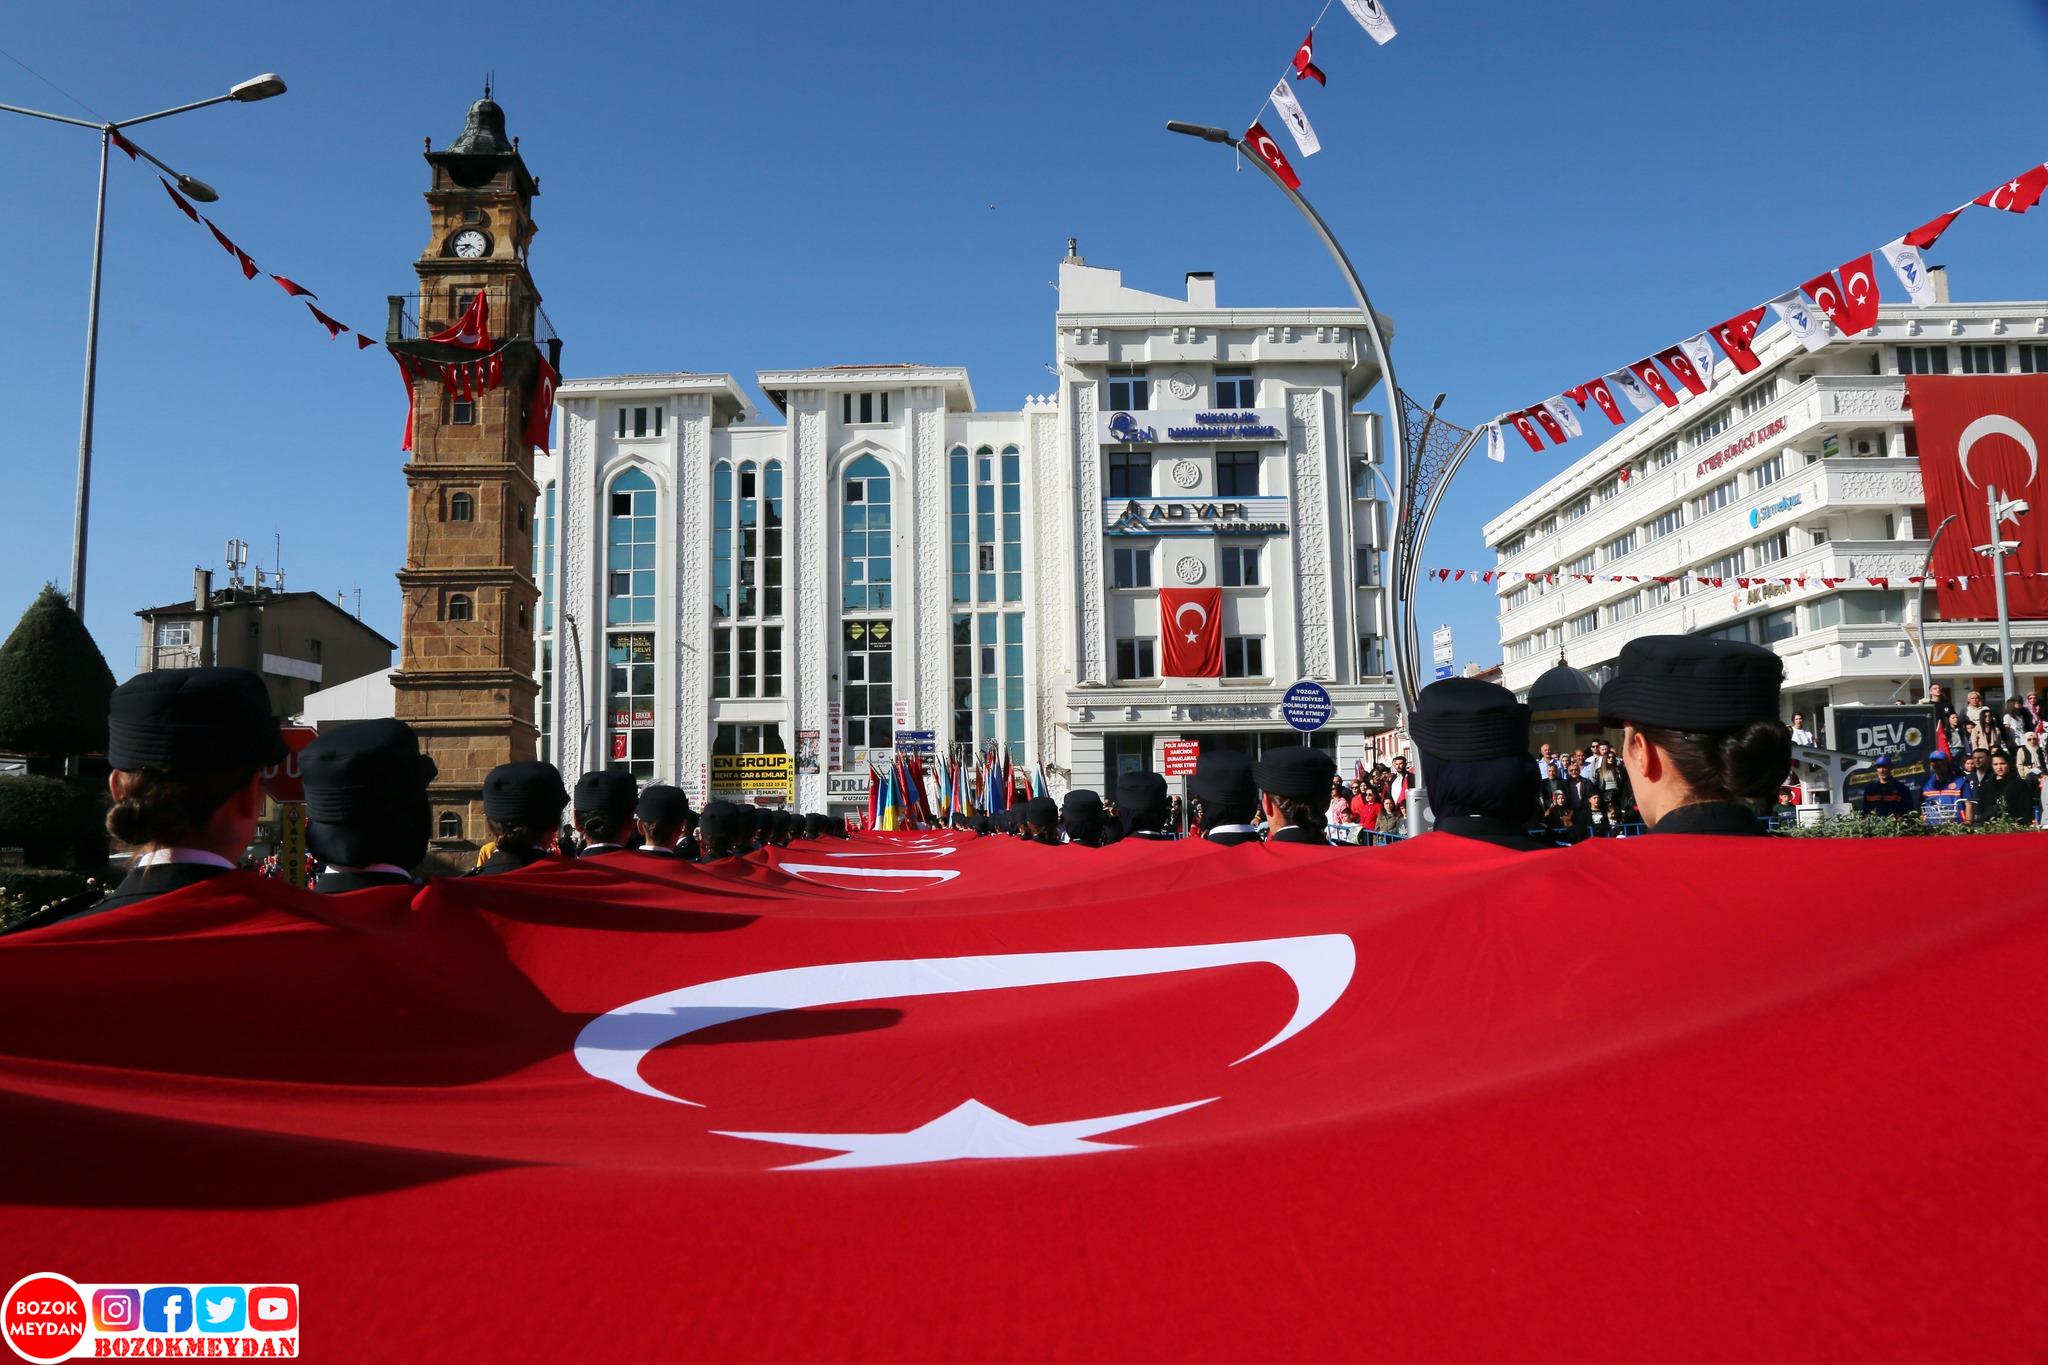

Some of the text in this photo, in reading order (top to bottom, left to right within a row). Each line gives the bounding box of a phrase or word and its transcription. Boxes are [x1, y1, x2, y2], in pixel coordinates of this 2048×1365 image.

[1757, 414, 1788, 444] KURSU
[1149, 503, 1242, 519] AD YAPI
[1856, 721, 1905, 750] DEV
[713, 757, 787, 767] EN GROUP
